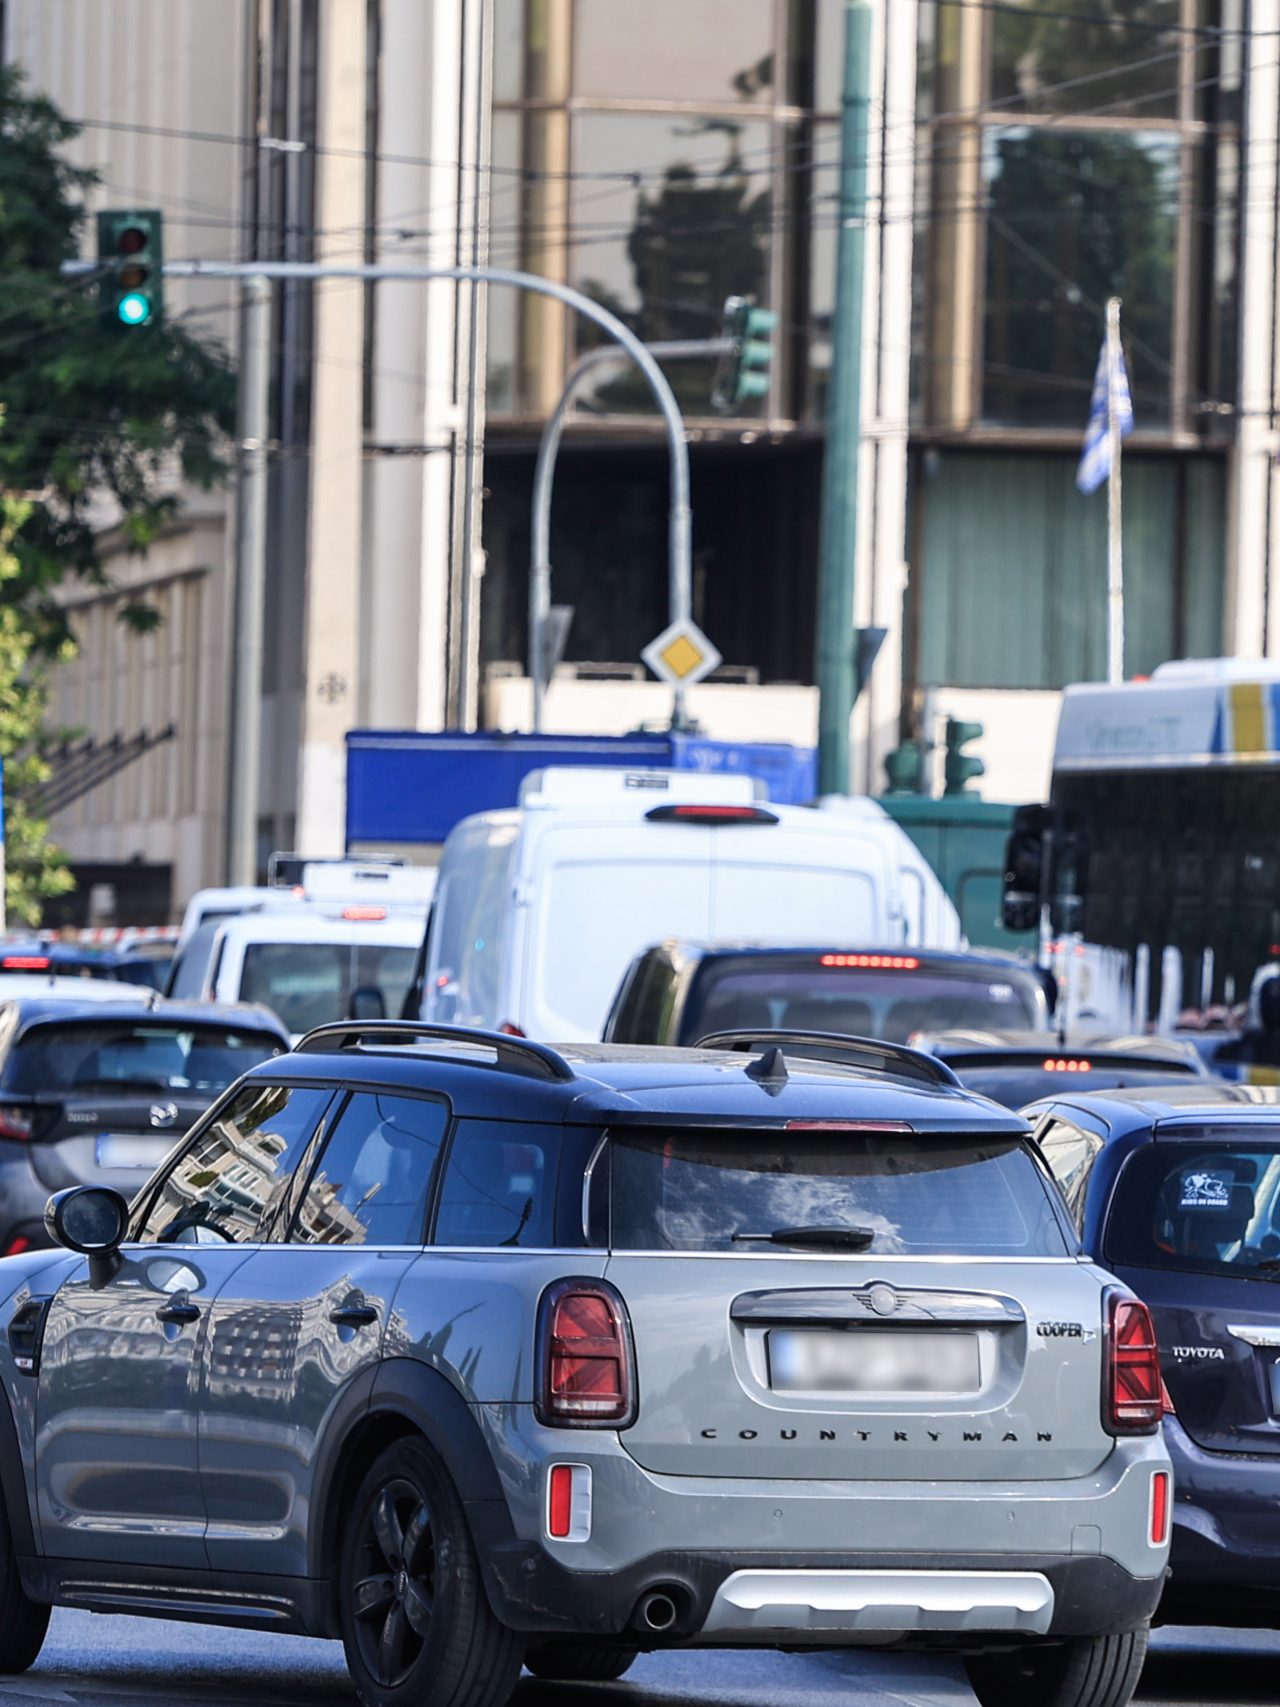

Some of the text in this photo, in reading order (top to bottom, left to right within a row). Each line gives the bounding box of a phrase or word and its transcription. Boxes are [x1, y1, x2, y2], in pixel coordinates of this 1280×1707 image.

[1037, 1322, 1082, 1337] COOPER
[1173, 1346, 1225, 1360] TOYOTA
[700, 1428, 1053, 1442] COUNTRYMAN
